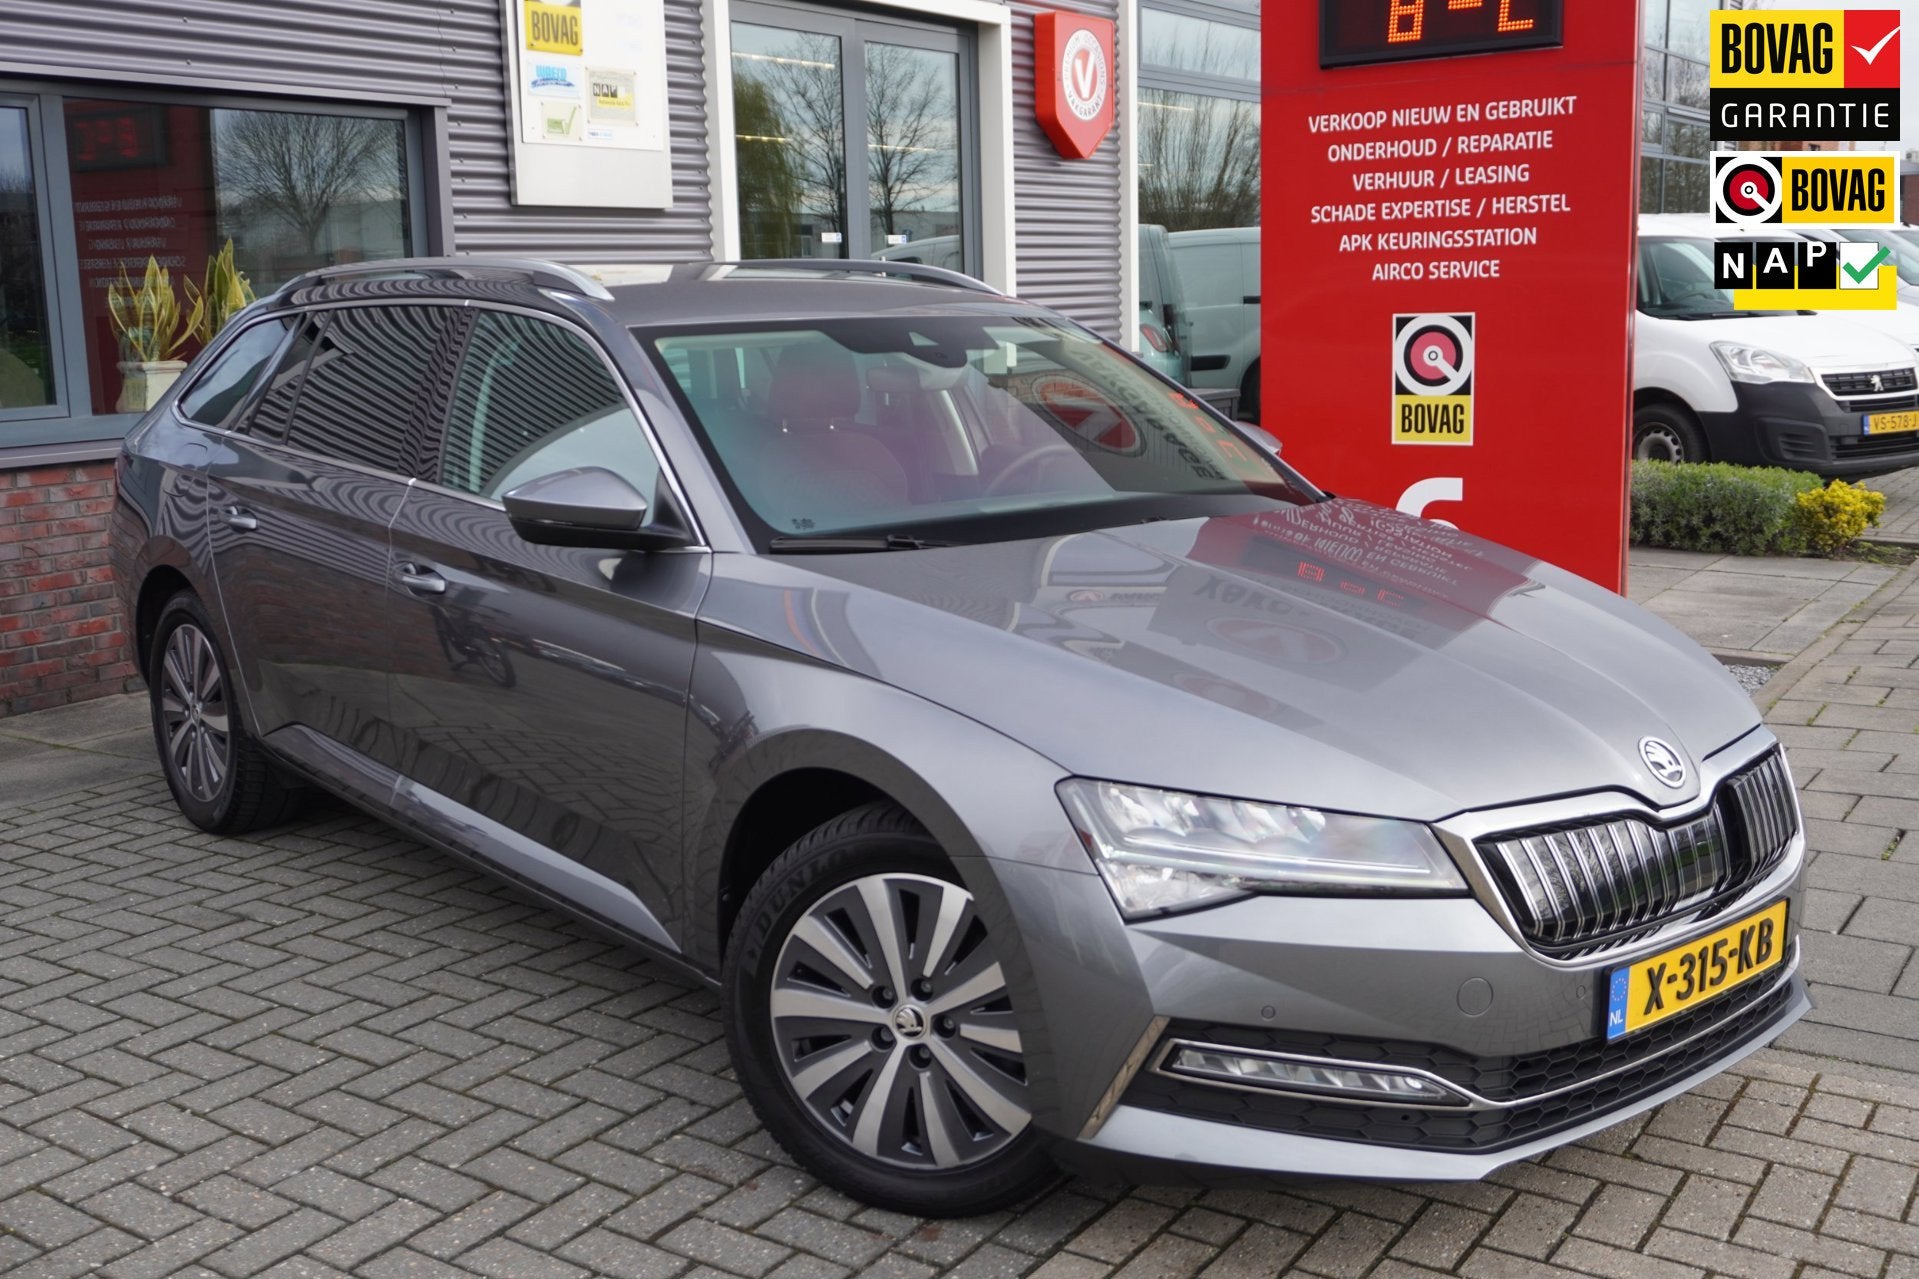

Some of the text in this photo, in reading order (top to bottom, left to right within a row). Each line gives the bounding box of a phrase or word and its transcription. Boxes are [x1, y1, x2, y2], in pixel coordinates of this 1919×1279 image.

[531, 10, 579, 46] BOVAG
[1309, 95, 1577, 133] VERKOOP NIEUW EN GEBRUIKT
[1327, 138, 1437, 162] ONDERHOUD
[1457, 129, 1553, 154] REPARATIE
[1352, 169, 1435, 191] VERHUUR
[1455, 163, 1530, 186] LEASING
[1310, 203, 1377, 224] SCHADE
[1381, 198, 1471, 220] EXPERTISE
[1492, 193, 1571, 215] HERSTEL
[1338, 226, 1537, 252] APK KEURINGSSTATION
[1371, 259, 1500, 281] AIRCO SERVICE
[1401, 403, 1465, 434] BOVAG
[1873, 413, 1918, 431] VS-578-J
[1643, 917, 1774, 1016] X-315-KB
[1609, 1009, 1624, 1027] NL
